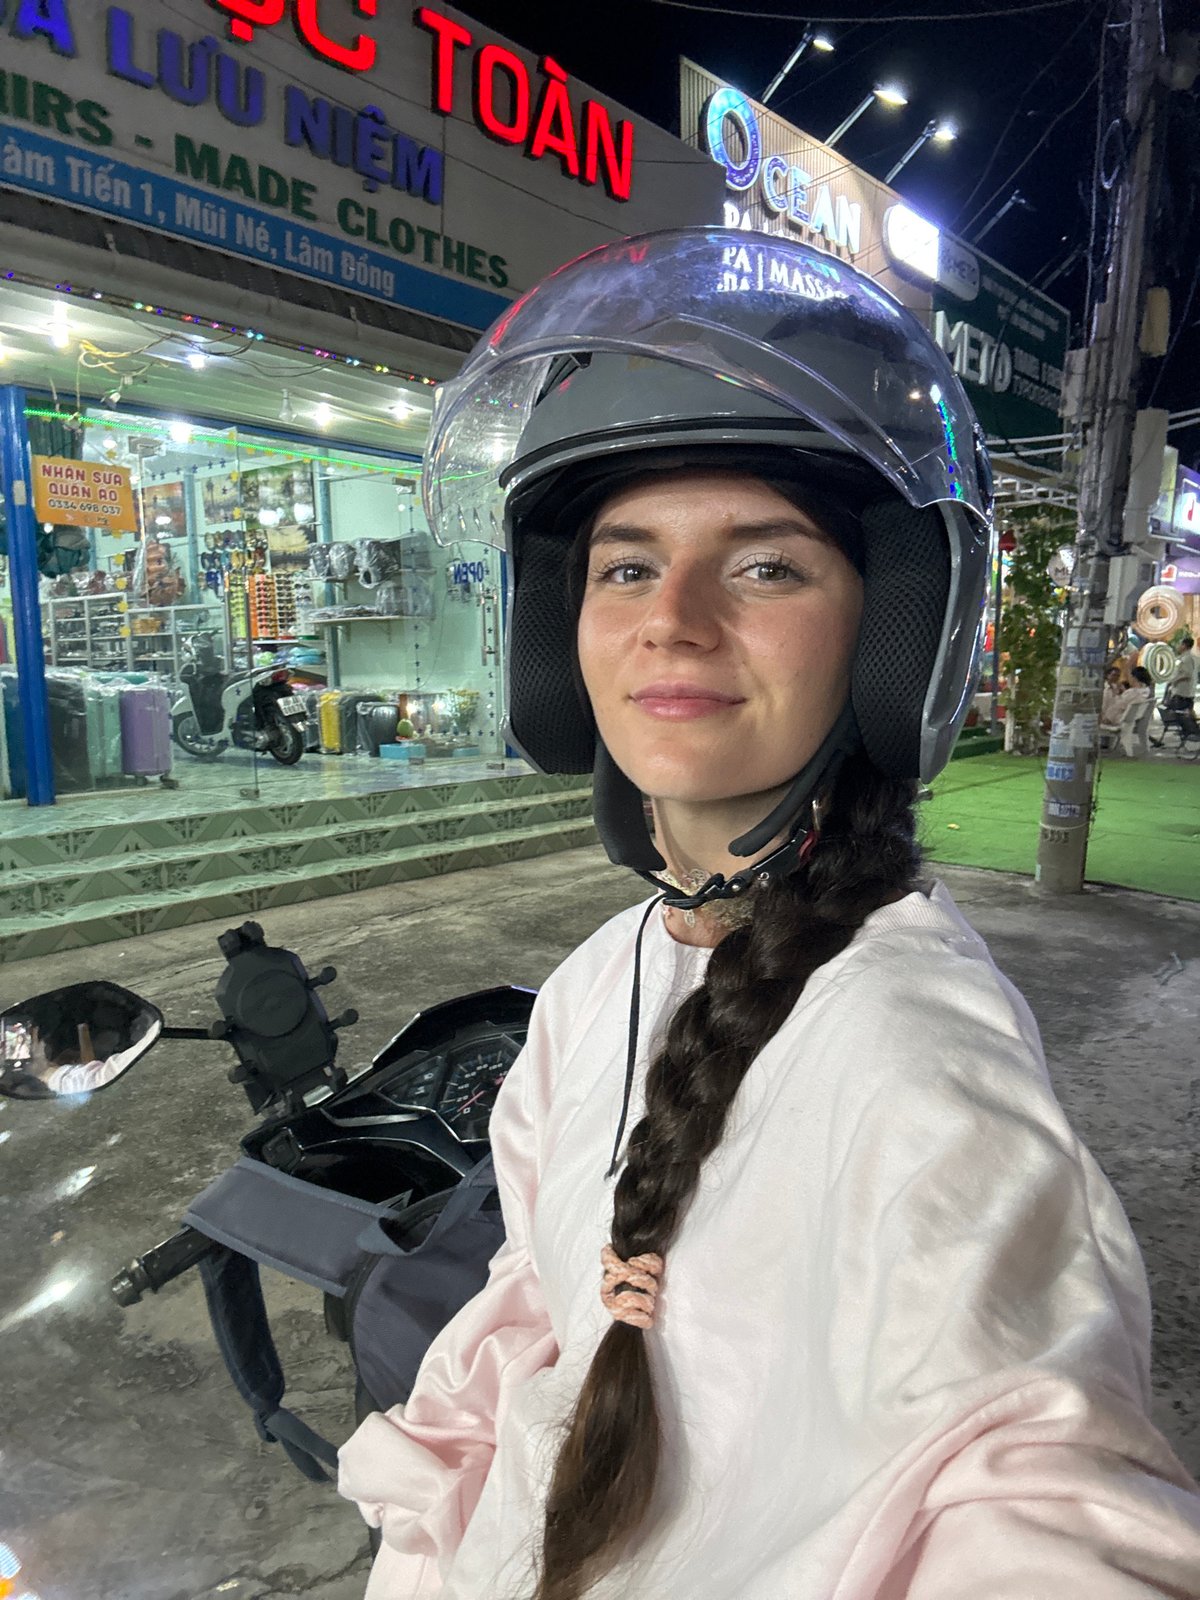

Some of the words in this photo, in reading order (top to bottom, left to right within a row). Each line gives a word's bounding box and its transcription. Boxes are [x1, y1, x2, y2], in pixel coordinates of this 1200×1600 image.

[106, 5, 265, 127] LƯU
[284, 85, 444, 205] NIỆM
[414, 6, 634, 202] TOÀN
[65, 156, 131, 209] Tiến
[175, 192, 227, 239] Mũi
[285, 231, 333, 275] Lâm
[174, 132, 317, 221] MADE
[337, 198, 508, 288] CLOTHES
